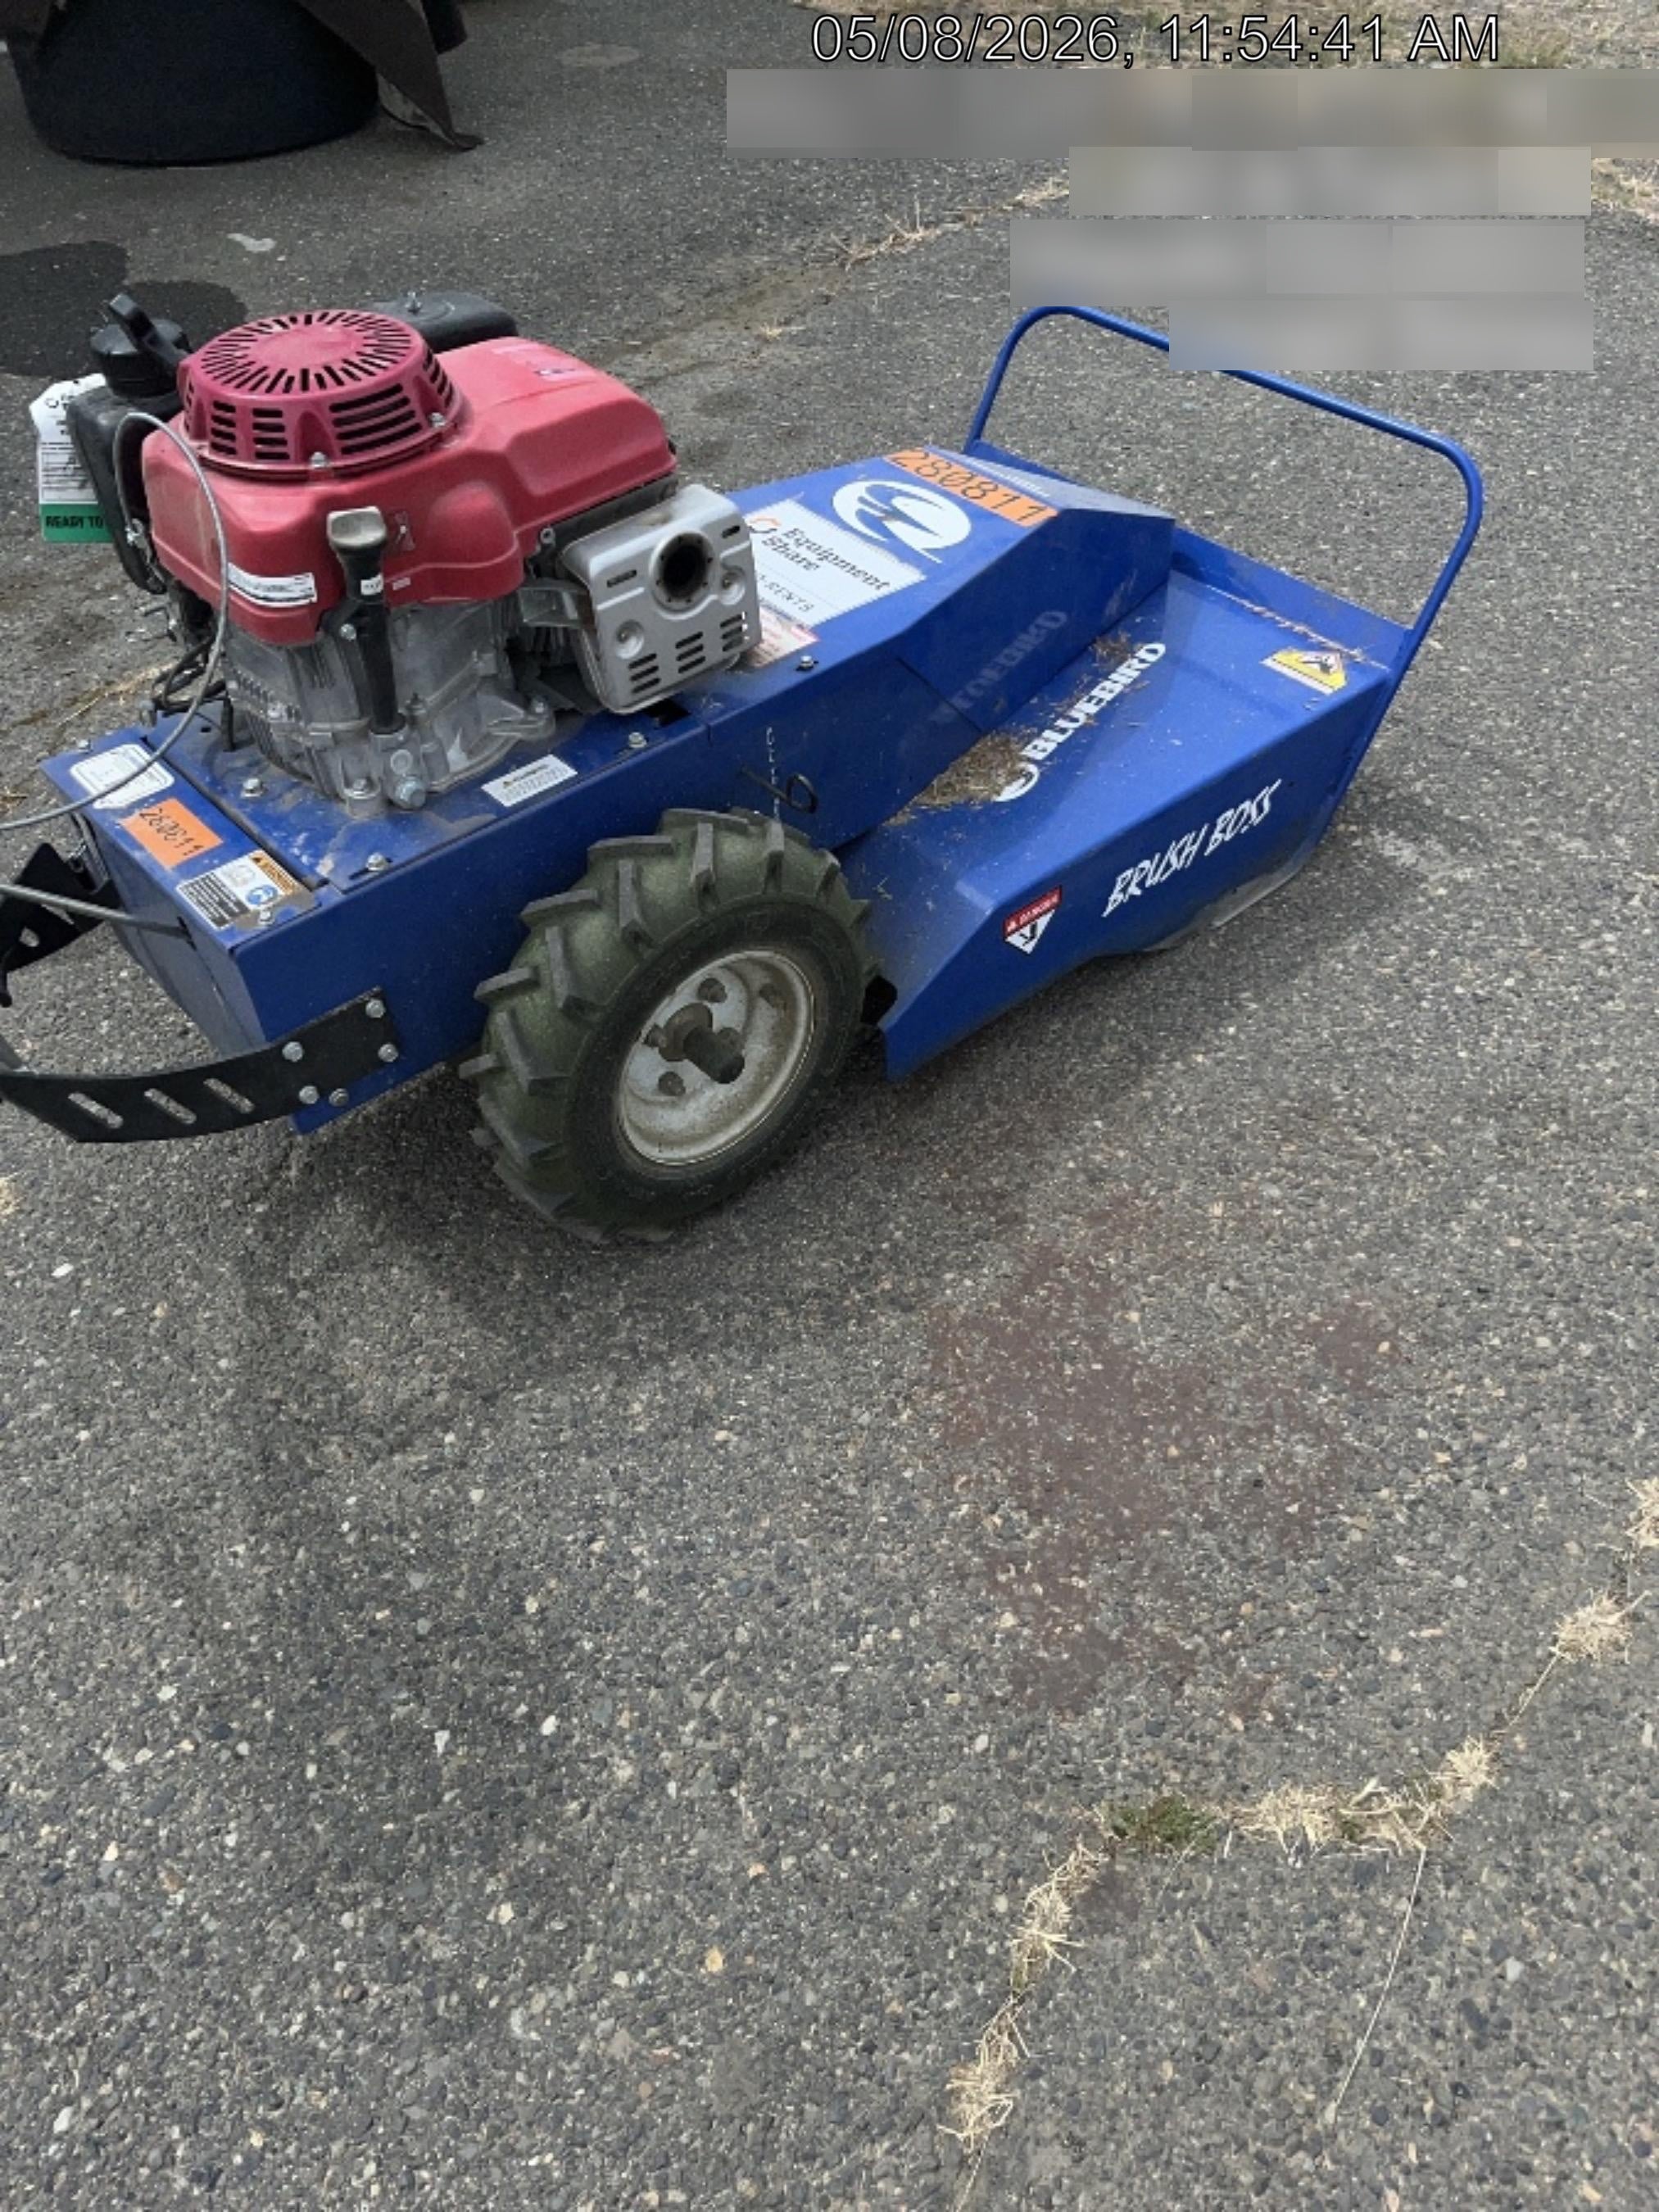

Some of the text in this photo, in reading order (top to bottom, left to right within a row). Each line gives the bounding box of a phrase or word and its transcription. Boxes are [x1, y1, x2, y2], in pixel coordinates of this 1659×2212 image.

[891, 449, 1047, 522] 280811
[45, 515, 83, 529] READY
[761, 535, 820, 572] Share
[783, 527, 892, 599] Equipment
[1021, 642, 1167, 760] BLUEBIRD
[1101, 777, 1283, 918] BRUSH BOSS
